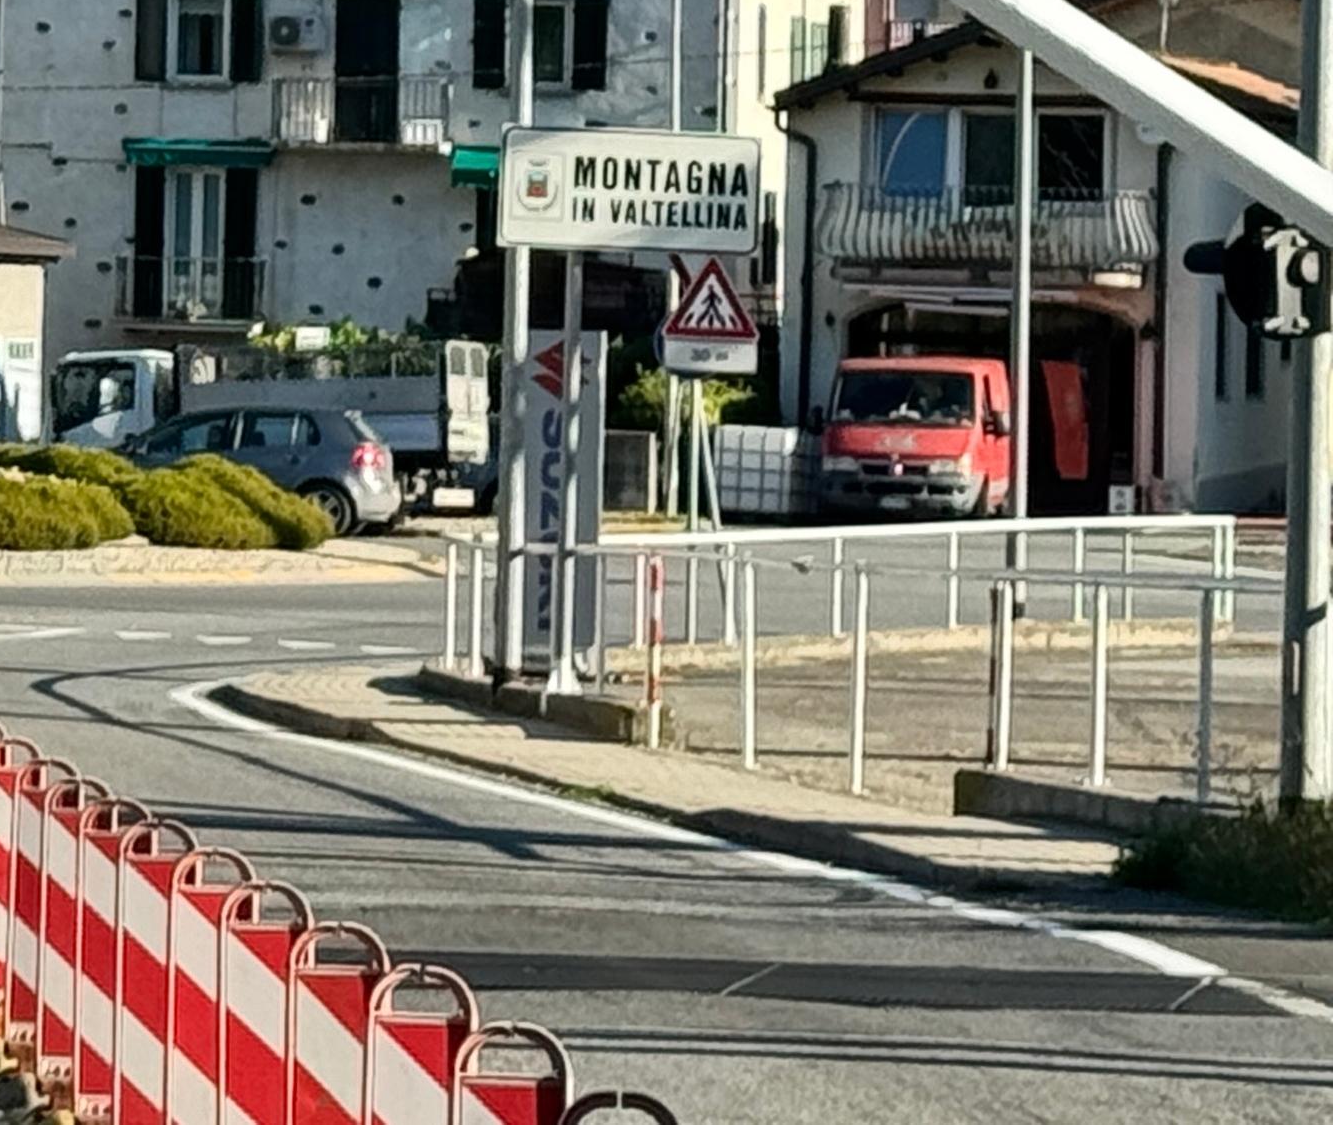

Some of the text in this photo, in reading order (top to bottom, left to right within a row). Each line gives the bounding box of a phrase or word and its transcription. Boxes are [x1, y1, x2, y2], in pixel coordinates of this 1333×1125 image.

[573, 155, 749, 197] MONTAGNA
[572, 196, 748, 231] IN VALTELLINA
